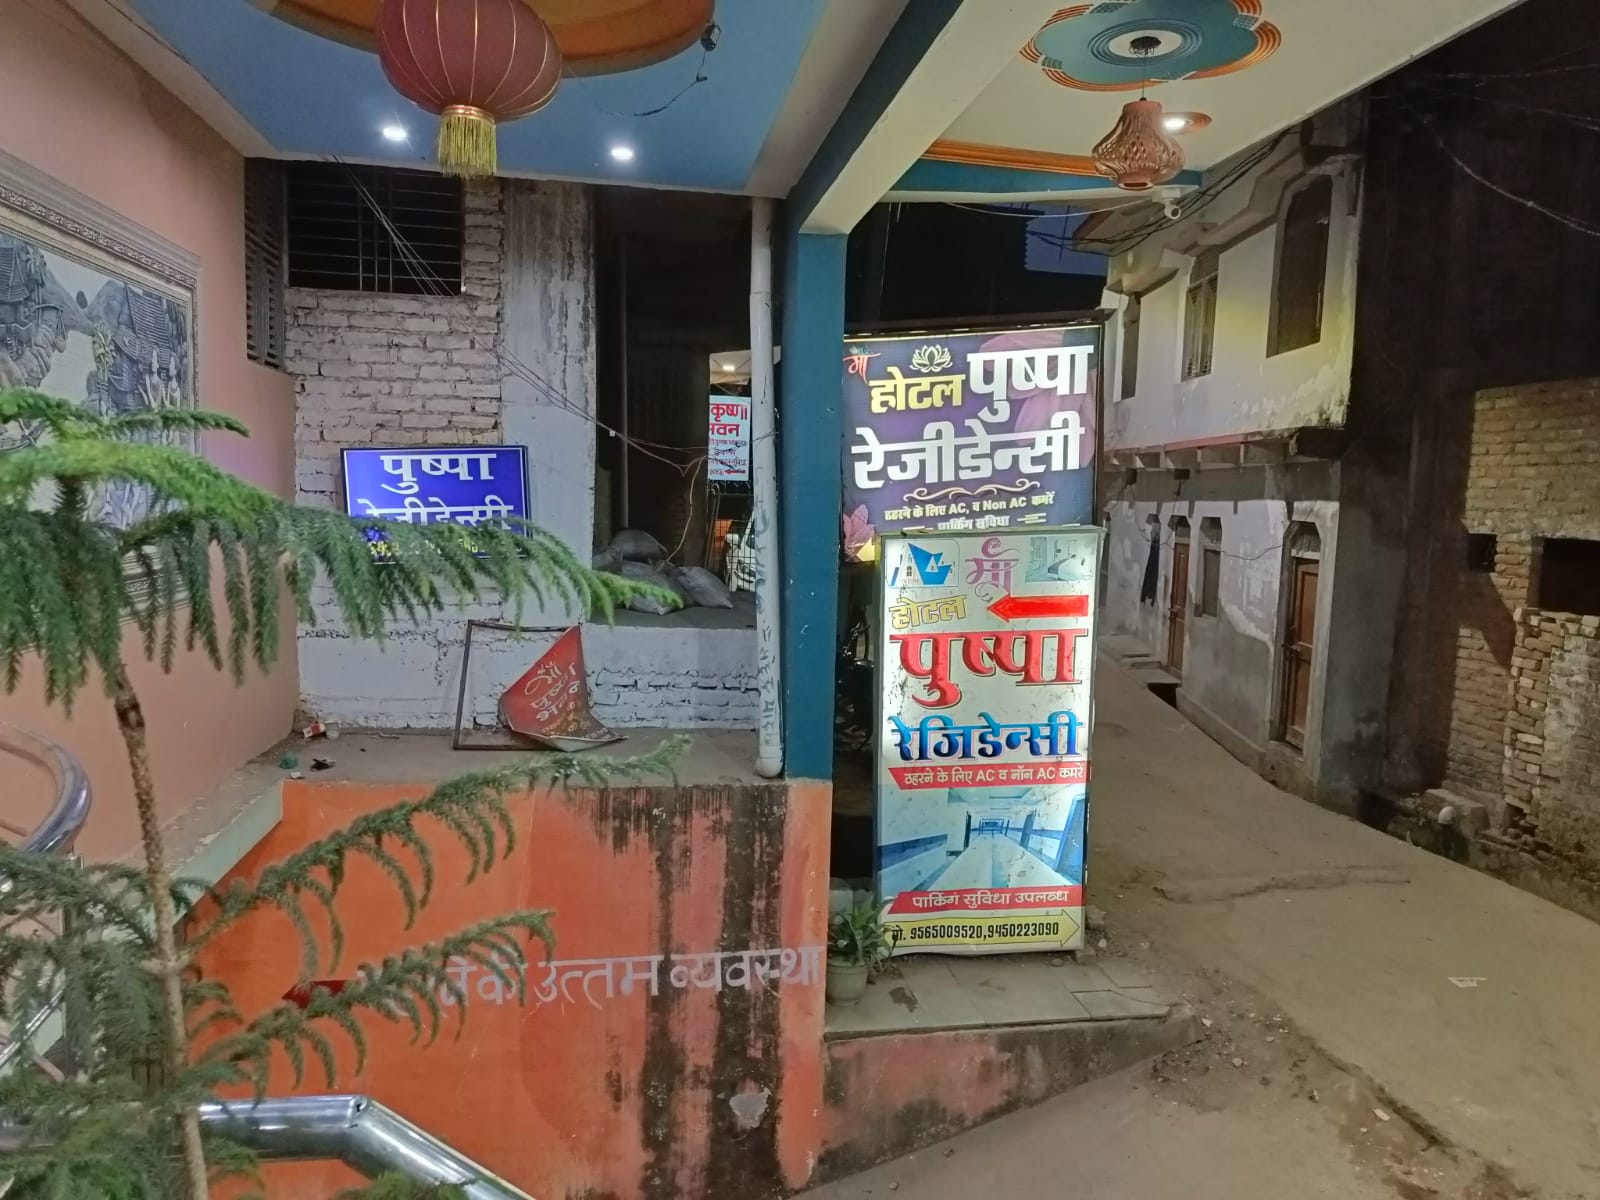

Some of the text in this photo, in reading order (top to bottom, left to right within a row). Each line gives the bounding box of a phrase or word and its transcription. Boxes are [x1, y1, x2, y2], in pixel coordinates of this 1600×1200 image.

[869, 345, 1094, 423] होटल पुष्पा
[851, 410, 1086, 489] रेजीडेन्सी
[380, 453, 496, 495] पुष्पा
[913, 505, 924, 517] के
[926, 503, 947, 516] लिए
[972, 501, 980, 512] व
[983, 499, 1006, 511] Non
[1009, 497, 1027, 509] AC
[889, 594, 967, 629] होटल
[889, 628, 1089, 709] पुष्पा
[887, 710, 1083, 762] रेजिडेन्सी
[904, 768, 934, 786] ठहरने
[937, 769, 949, 783] के
[951, 766, 973, 784] लिए
[976, 768, 995, 781] AC
[999, 768, 1008, 780] व
[1011, 765, 1034, 780] नॉन
[1037, 767, 1056, 779] AC
[963, 890, 1011, 909] सुविधा
[534, 955, 664, 1010] उत्तम
[668, 944, 823, 997] व्यवस्था
